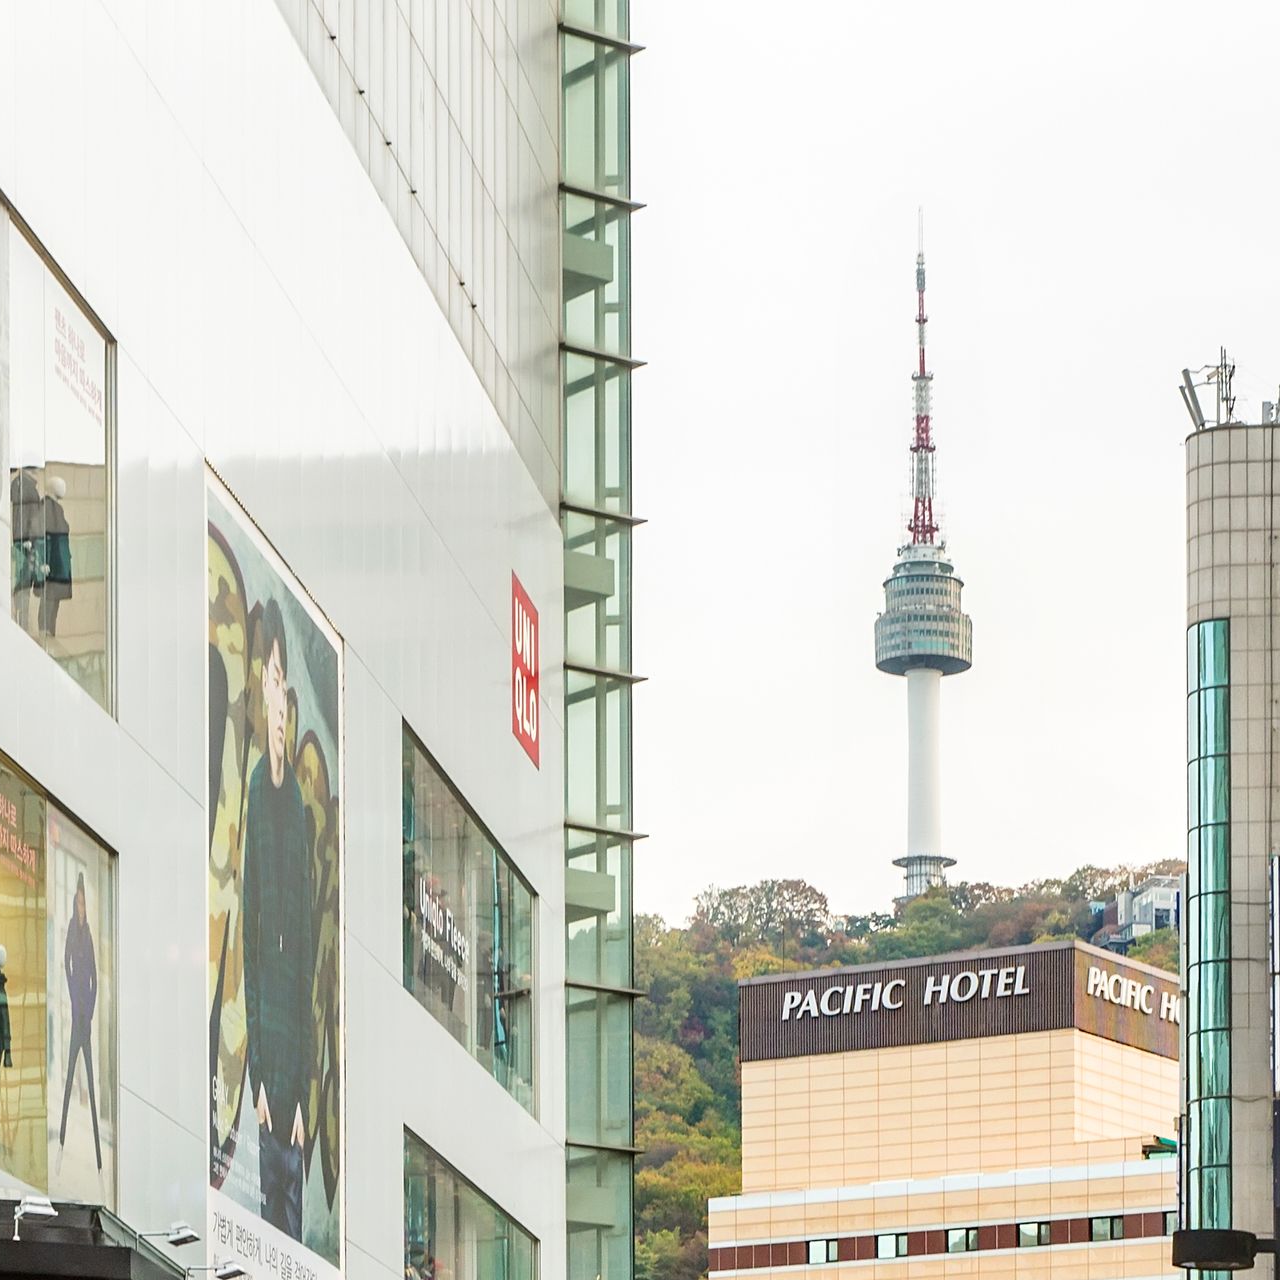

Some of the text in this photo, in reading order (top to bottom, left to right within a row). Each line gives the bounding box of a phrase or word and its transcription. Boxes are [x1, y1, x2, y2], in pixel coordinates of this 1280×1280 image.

[782, 966, 1030, 1022] PACIFIC HOTEL
[1088, 967, 1153, 1015] PACIFIC
